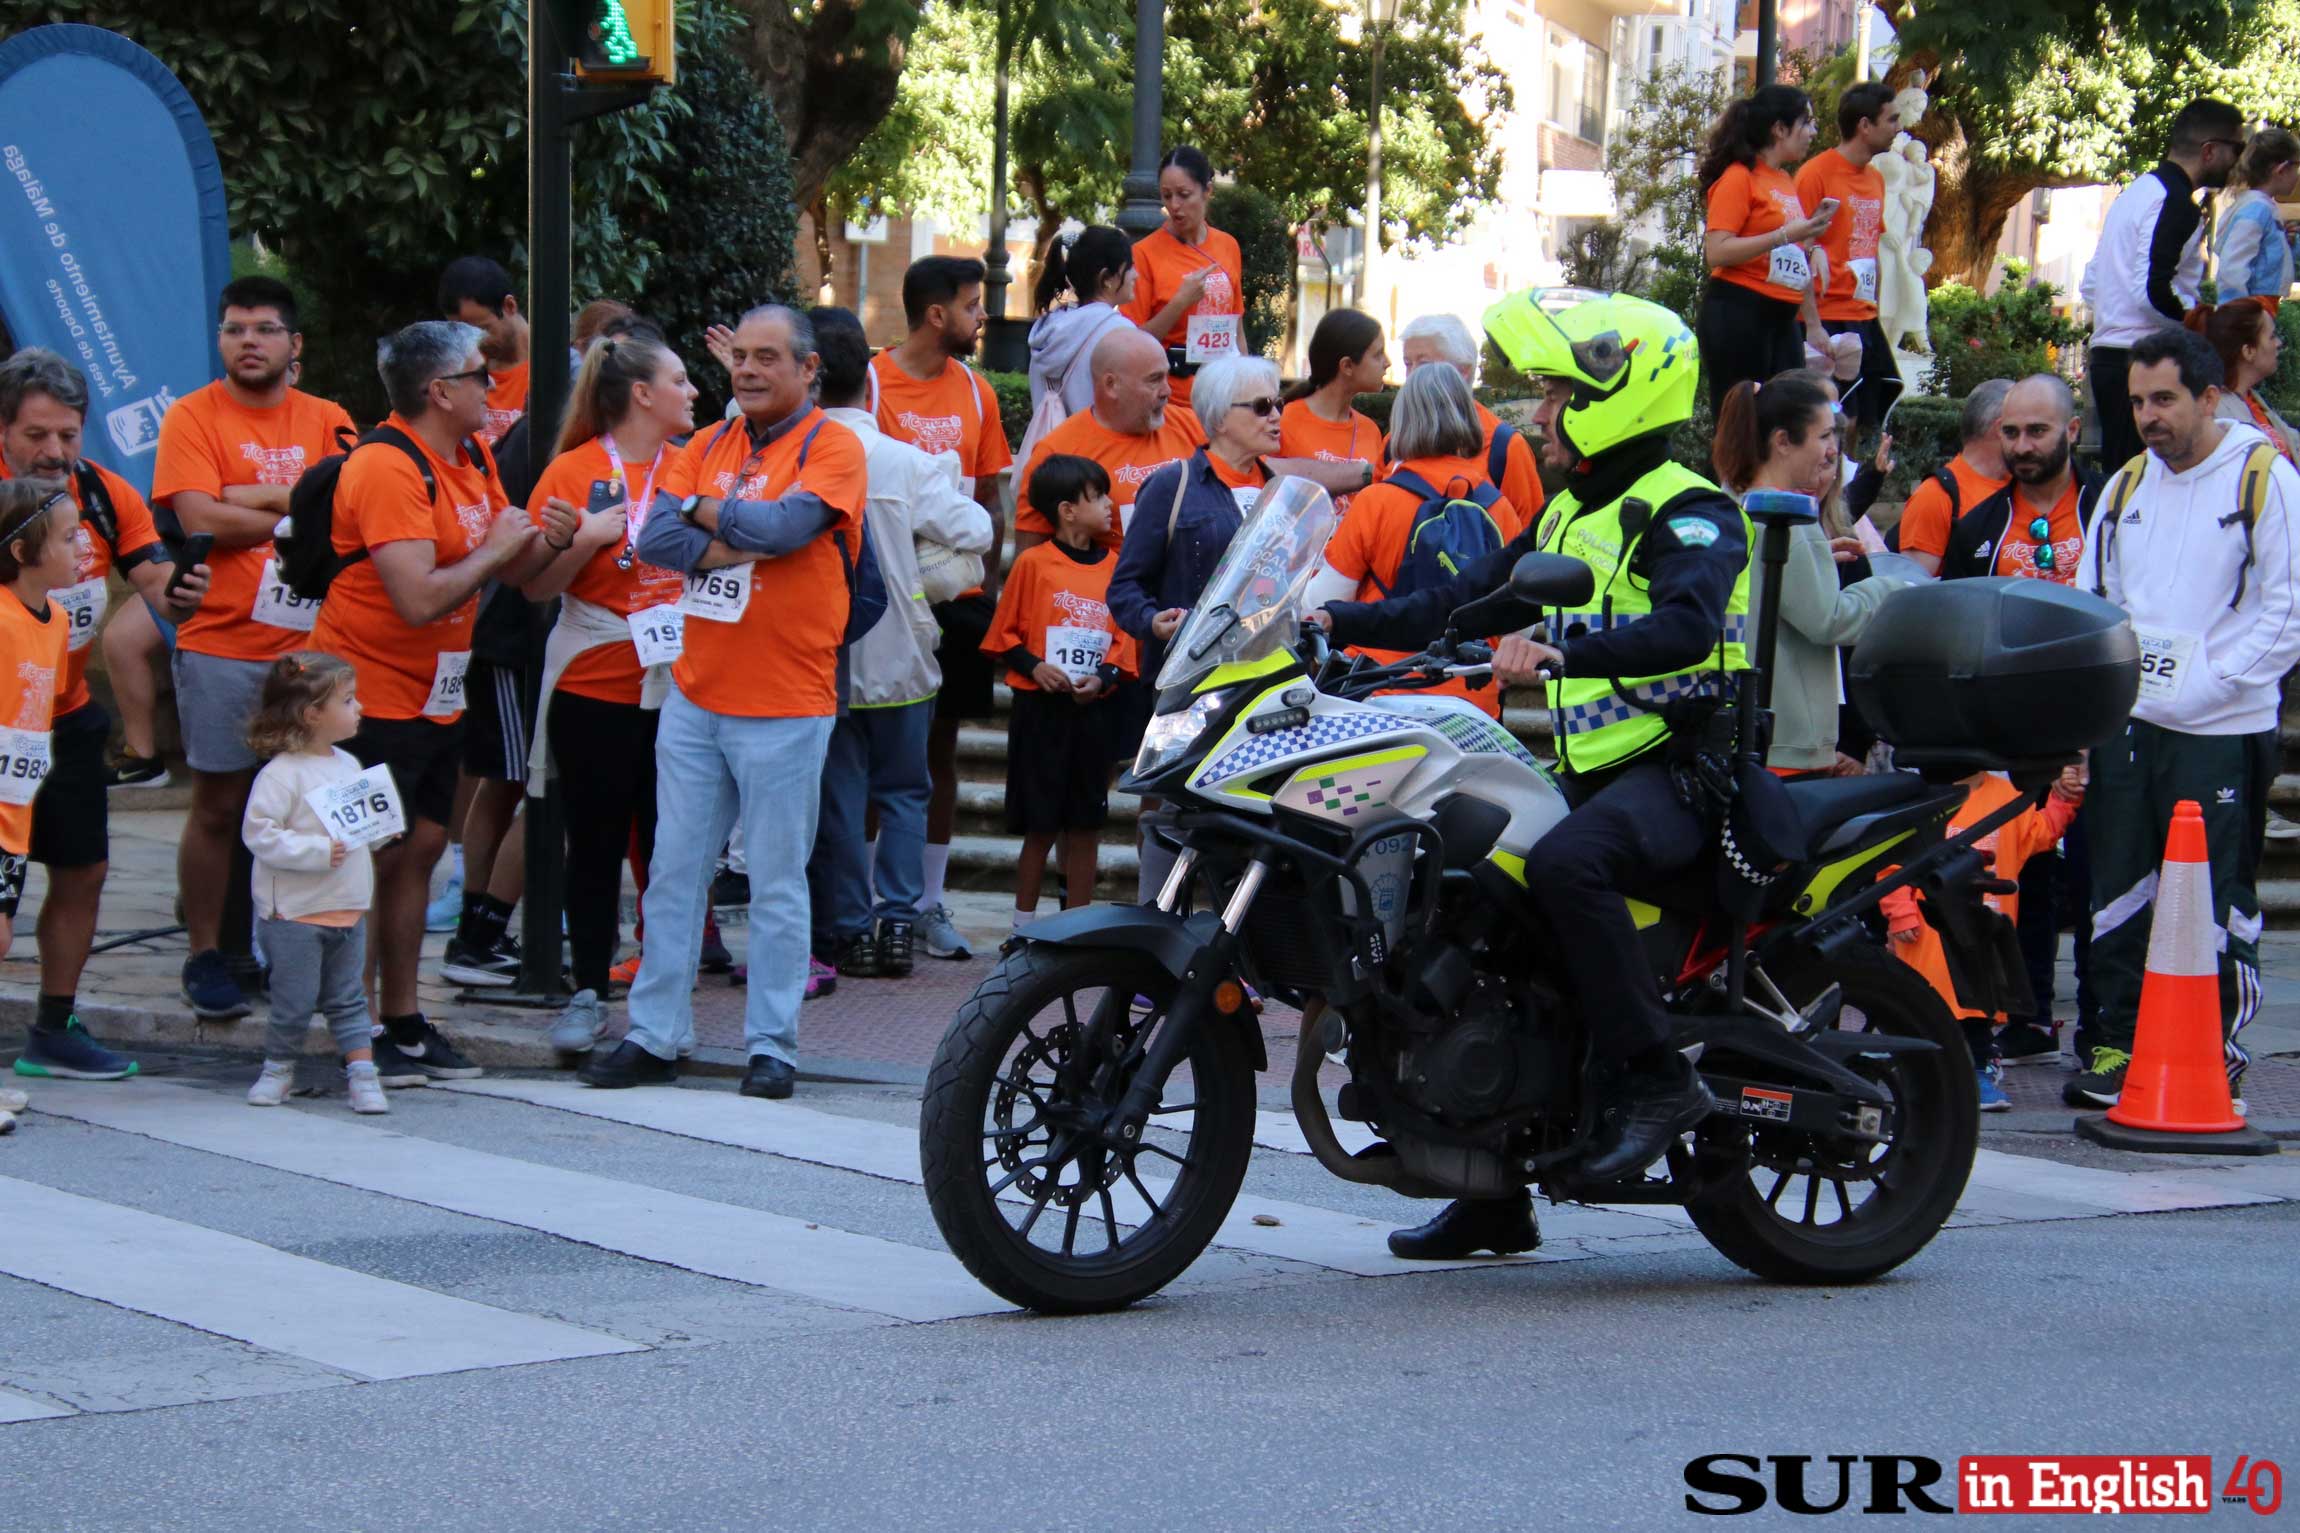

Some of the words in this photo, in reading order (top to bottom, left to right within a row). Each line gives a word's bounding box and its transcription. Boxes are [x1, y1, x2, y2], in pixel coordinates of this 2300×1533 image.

[1197, 332, 1231, 349] 423
[270, 586, 324, 610] 197
[687, 573, 741, 599] 1769
[643, 624, 684, 642] 19
[1056, 648, 1103, 668] 1872
[0, 754, 48, 780] 1983
[330, 792, 389, 828] 1876
